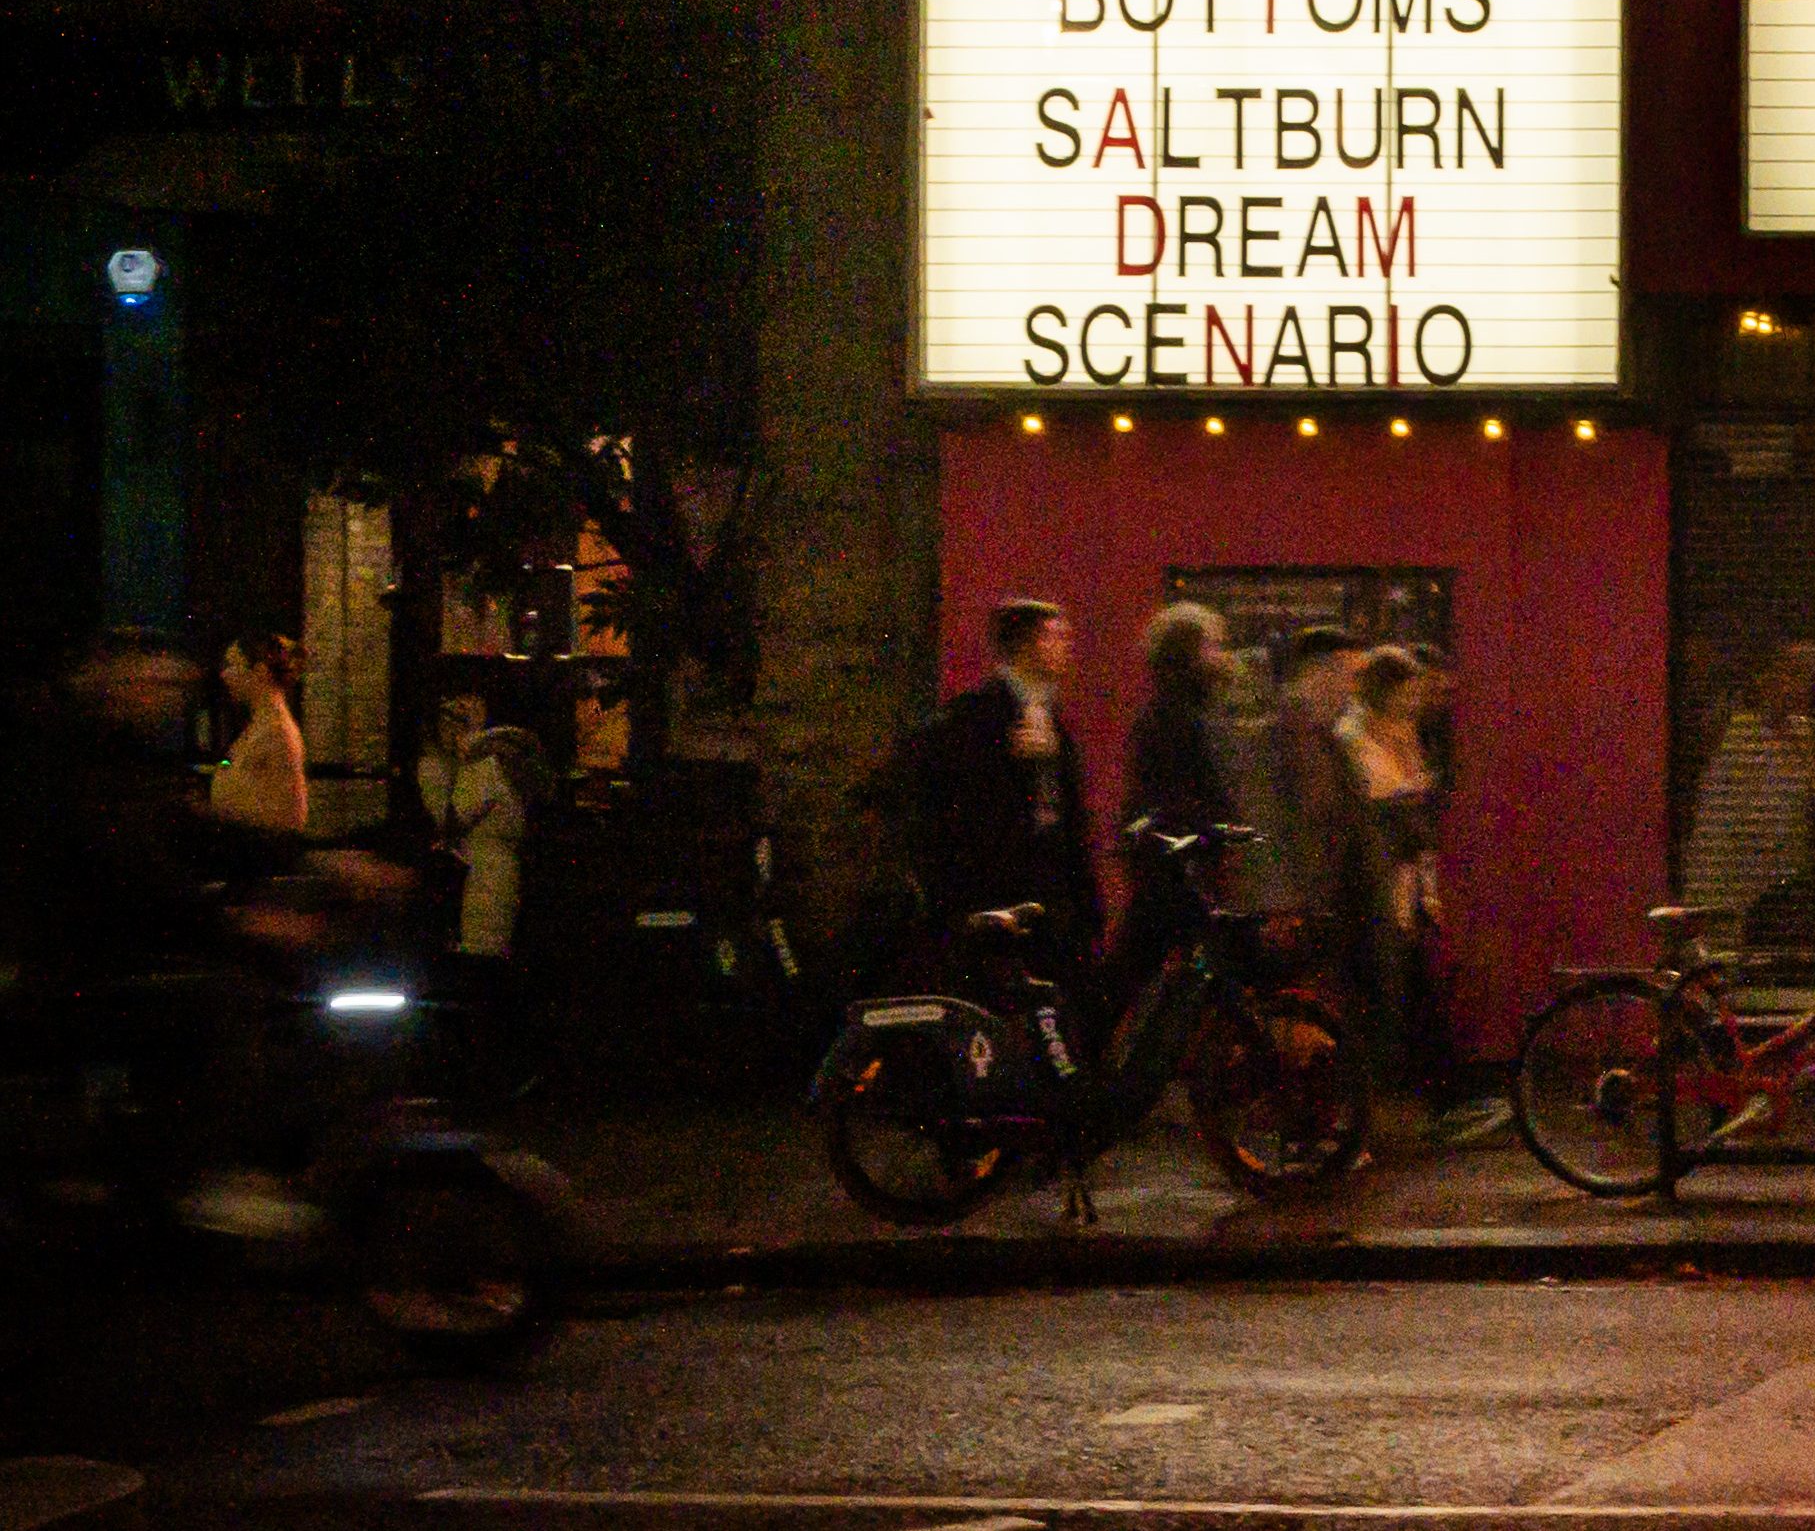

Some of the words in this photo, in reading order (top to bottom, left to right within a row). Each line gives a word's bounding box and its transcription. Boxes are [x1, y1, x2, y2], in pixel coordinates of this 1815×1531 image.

[1036, 87, 1505, 170] SALTBURN
[1116, 195, 1417, 278] DREAM
[1022, 304, 1473, 388] SCENARIO
